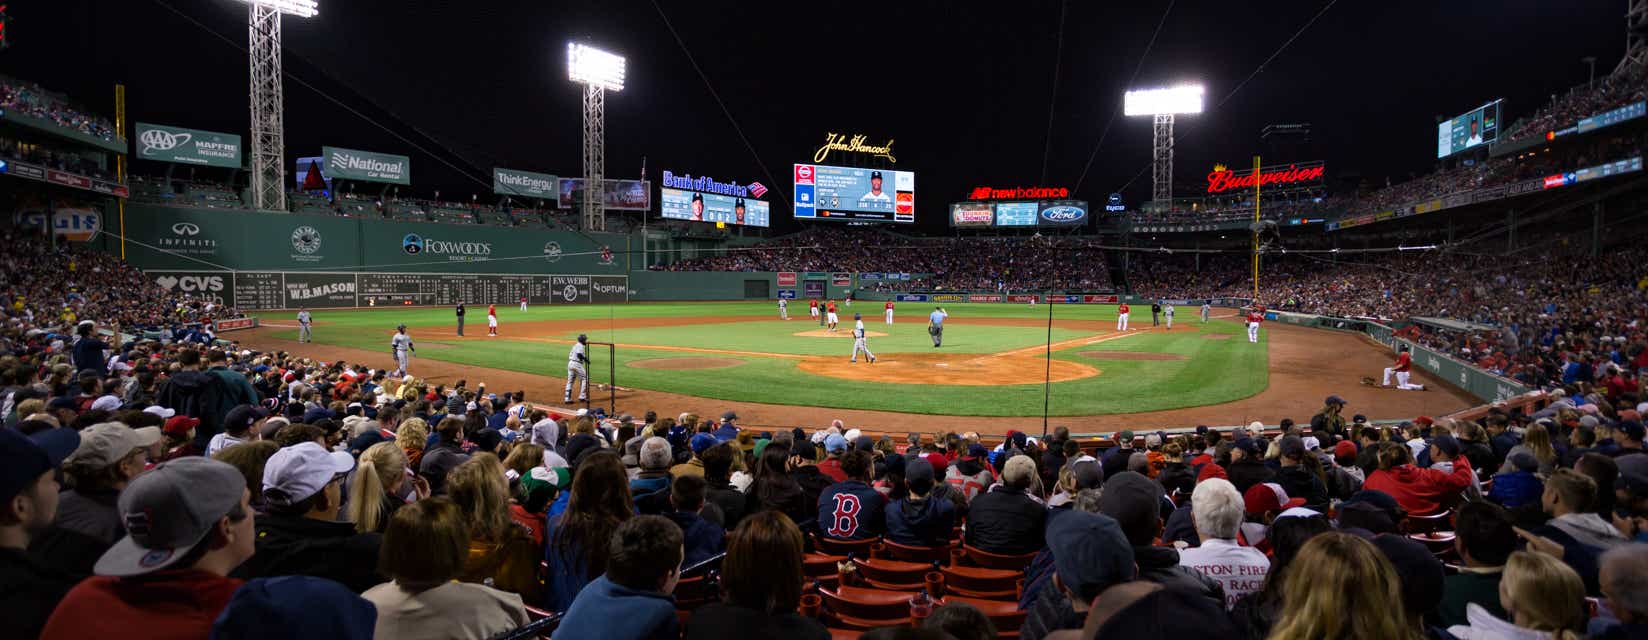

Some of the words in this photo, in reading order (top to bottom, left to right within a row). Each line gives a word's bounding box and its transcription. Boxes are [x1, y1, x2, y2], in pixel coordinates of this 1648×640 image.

[145, 132, 173, 145] AAA
[195, 141, 238, 151] MAPFRE
[814, 132, 849, 163] John
[848, 134, 897, 163] Hancock
[198, 149, 235, 159] INSURANCE
[348, 156, 402, 174] National
[663, 170, 694, 190] Bank
[693, 175, 706, 191] of
[705, 177, 748, 197] America
[1207, 164, 1325, 193] Budweiser
[1050, 208, 1076, 219] Ford
[159, 238, 216, 247] INFINITI
[179, 276, 224, 292] CVS
[601, 285, 626, 293] OPTUM
[827, 492, 863, 538] B
[1238, 565, 1266, 576] FIRE
